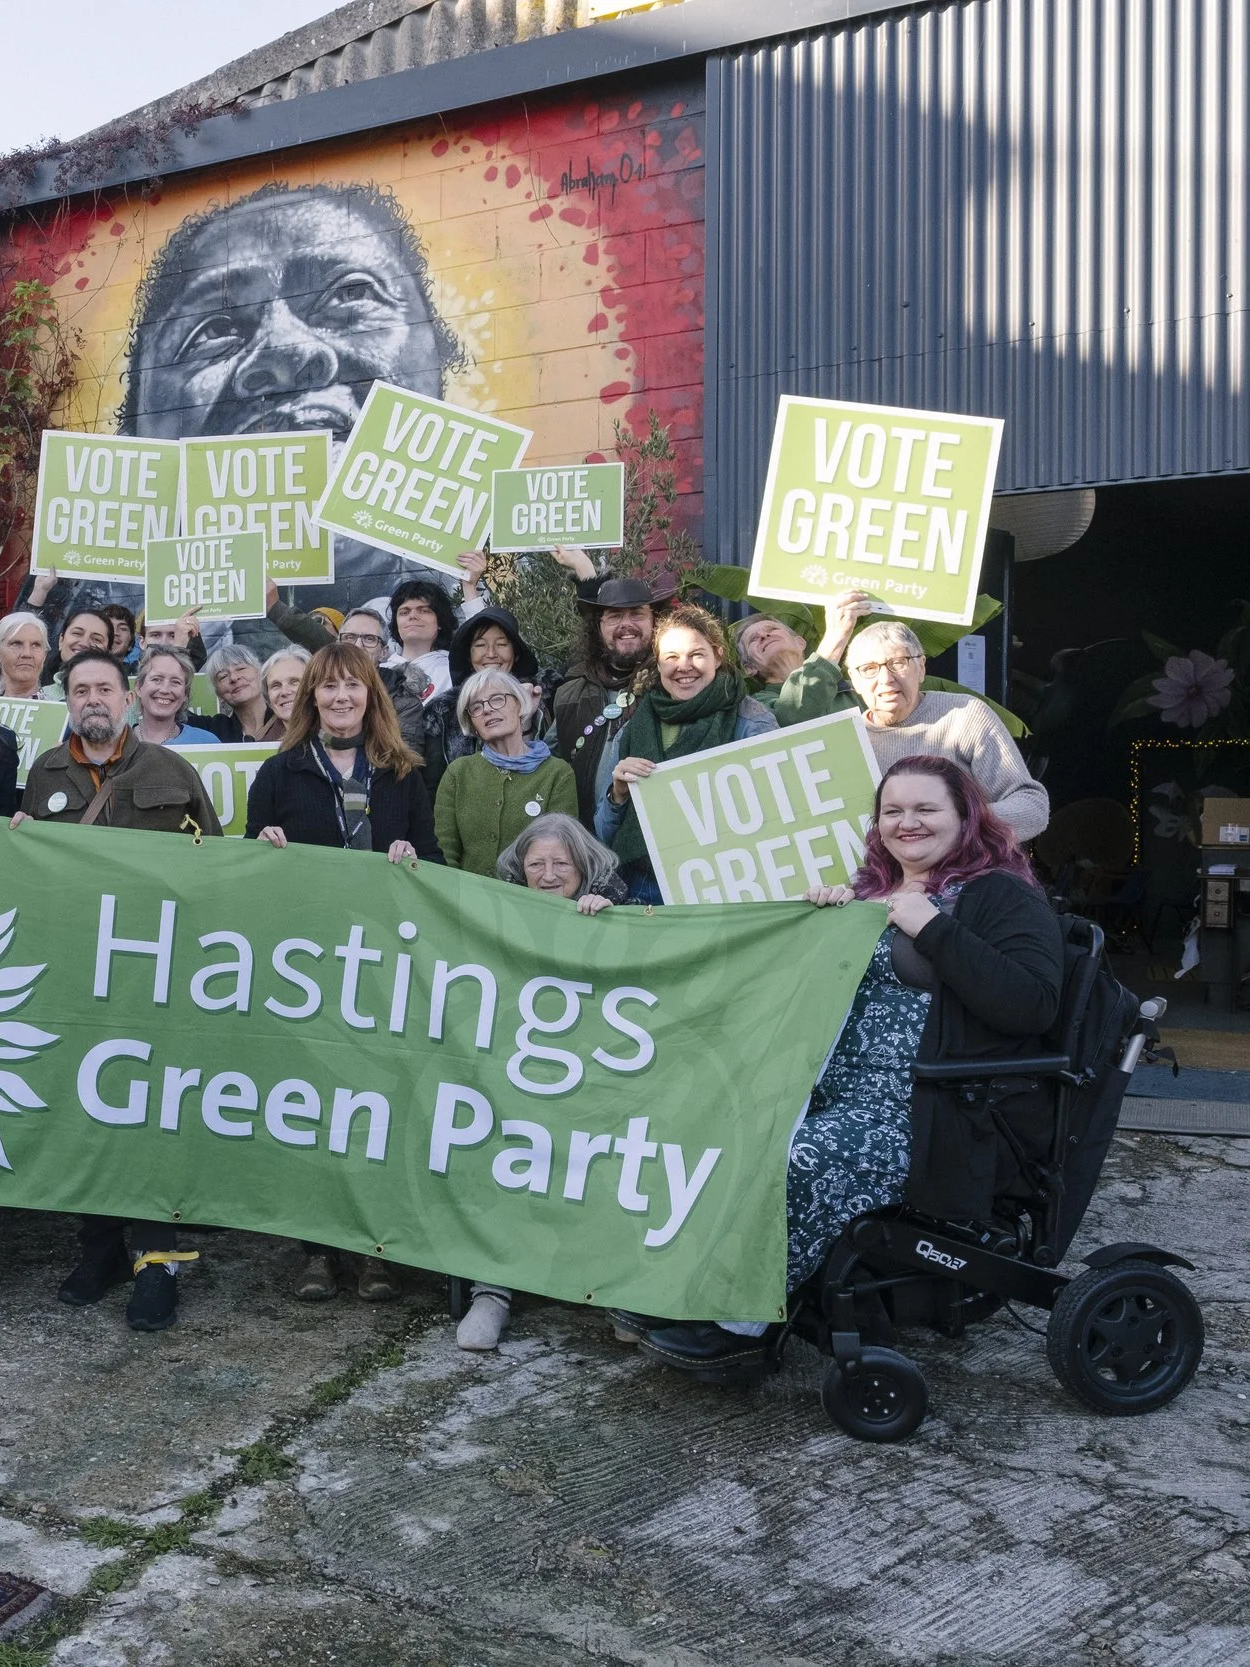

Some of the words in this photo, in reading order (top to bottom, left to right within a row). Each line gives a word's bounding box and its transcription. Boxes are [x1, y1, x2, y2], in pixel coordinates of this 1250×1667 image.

[382, 402, 499, 482] VOTE
[815, 418, 961, 499] VOTE
[66, 445, 162, 499] VOTE
[206, 445, 307, 498] VOTE
[342, 452, 490, 541] GREEN
[526, 470, 589, 501] VOTE
[46, 496, 169, 550] GREEN
[375, 519, 410, 540] Green
[411, 532, 444, 553] Party
[512, 499, 601, 535] GREEN
[777, 488, 968, 575] GREEN
[83, 554, 115, 567] Green
[117, 556, 145, 572] Party
[176, 538, 234, 572] VOTE
[272, 559, 302, 572] Party
[163, 568, 246, 608] GREEN
[832, 572, 880, 590] Green
[885, 578, 928, 599] Party
[670, 740, 844, 846] VOTE
[93, 894, 660, 1095] Hastings
[76, 1038, 391, 1162] Green
[428, 1081, 722, 1248] Party
